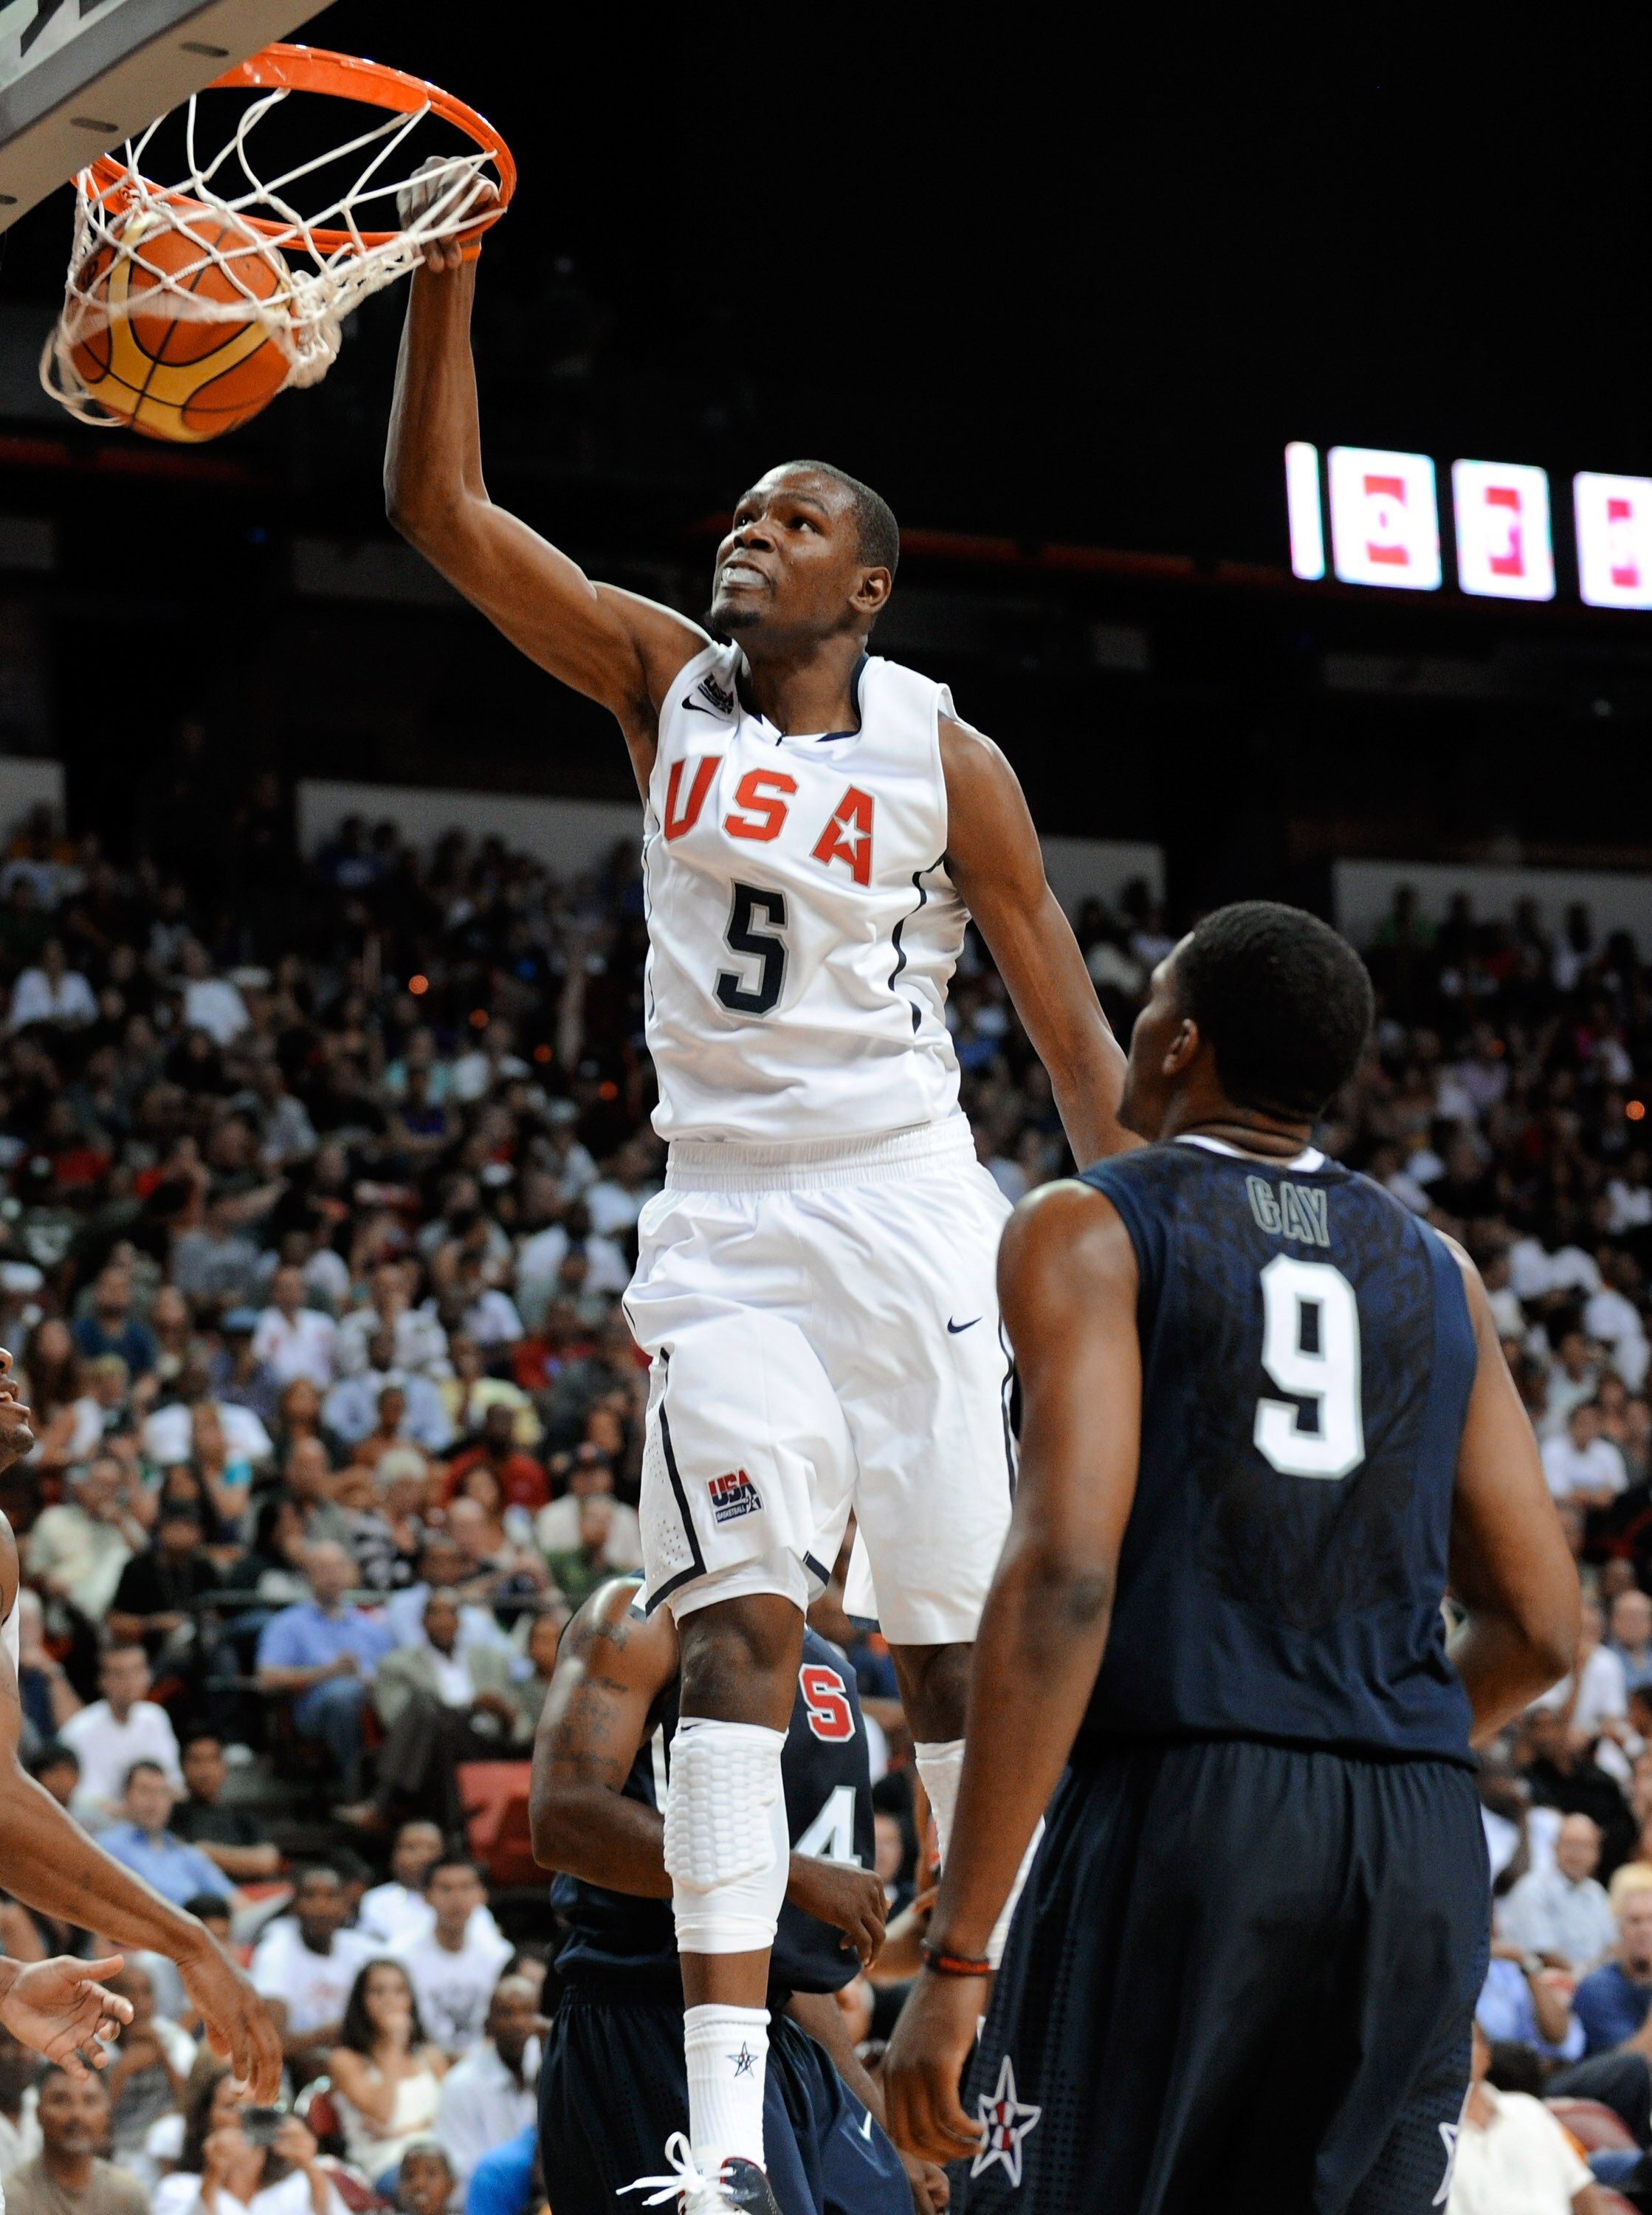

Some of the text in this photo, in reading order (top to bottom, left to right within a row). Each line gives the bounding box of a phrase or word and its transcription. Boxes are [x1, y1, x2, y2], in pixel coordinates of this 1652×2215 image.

[664, 756, 875, 888] USA
[712, 877, 790, 1018] 5
[1245, 1175, 1331, 1248] GAY
[1253, 1252, 1366, 1480] 9
[708, 1469, 762, 1509] USA
[793, 1785, 862, 1868] 4
